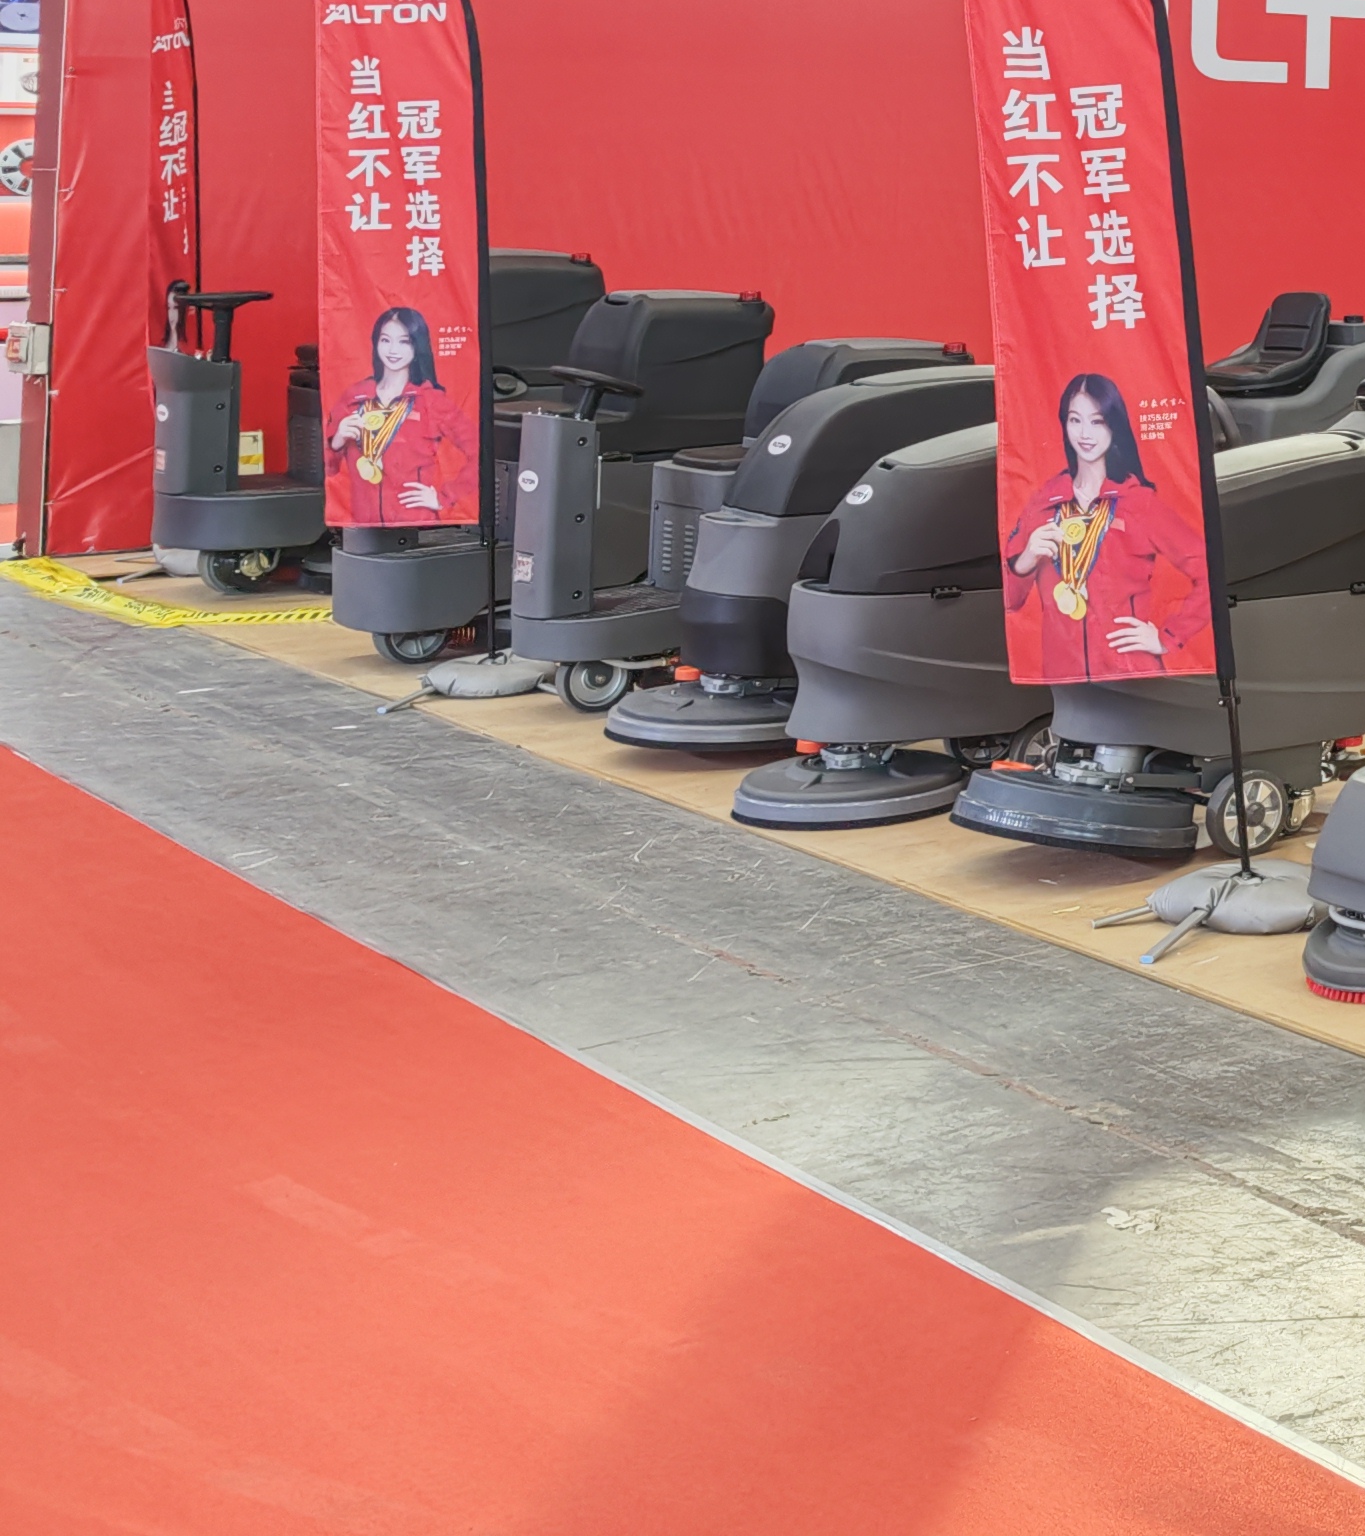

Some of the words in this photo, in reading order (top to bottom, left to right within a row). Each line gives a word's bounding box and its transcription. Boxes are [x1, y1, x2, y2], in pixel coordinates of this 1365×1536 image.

[322, 1, 447, 25] ALTON
[346, 55, 393, 232] 当红不让
[397, 99, 446, 278] 冠军选择
[1001, 26, 1066, 270] 当红不让
[1070, 84, 1145, 331] 冠军选择
